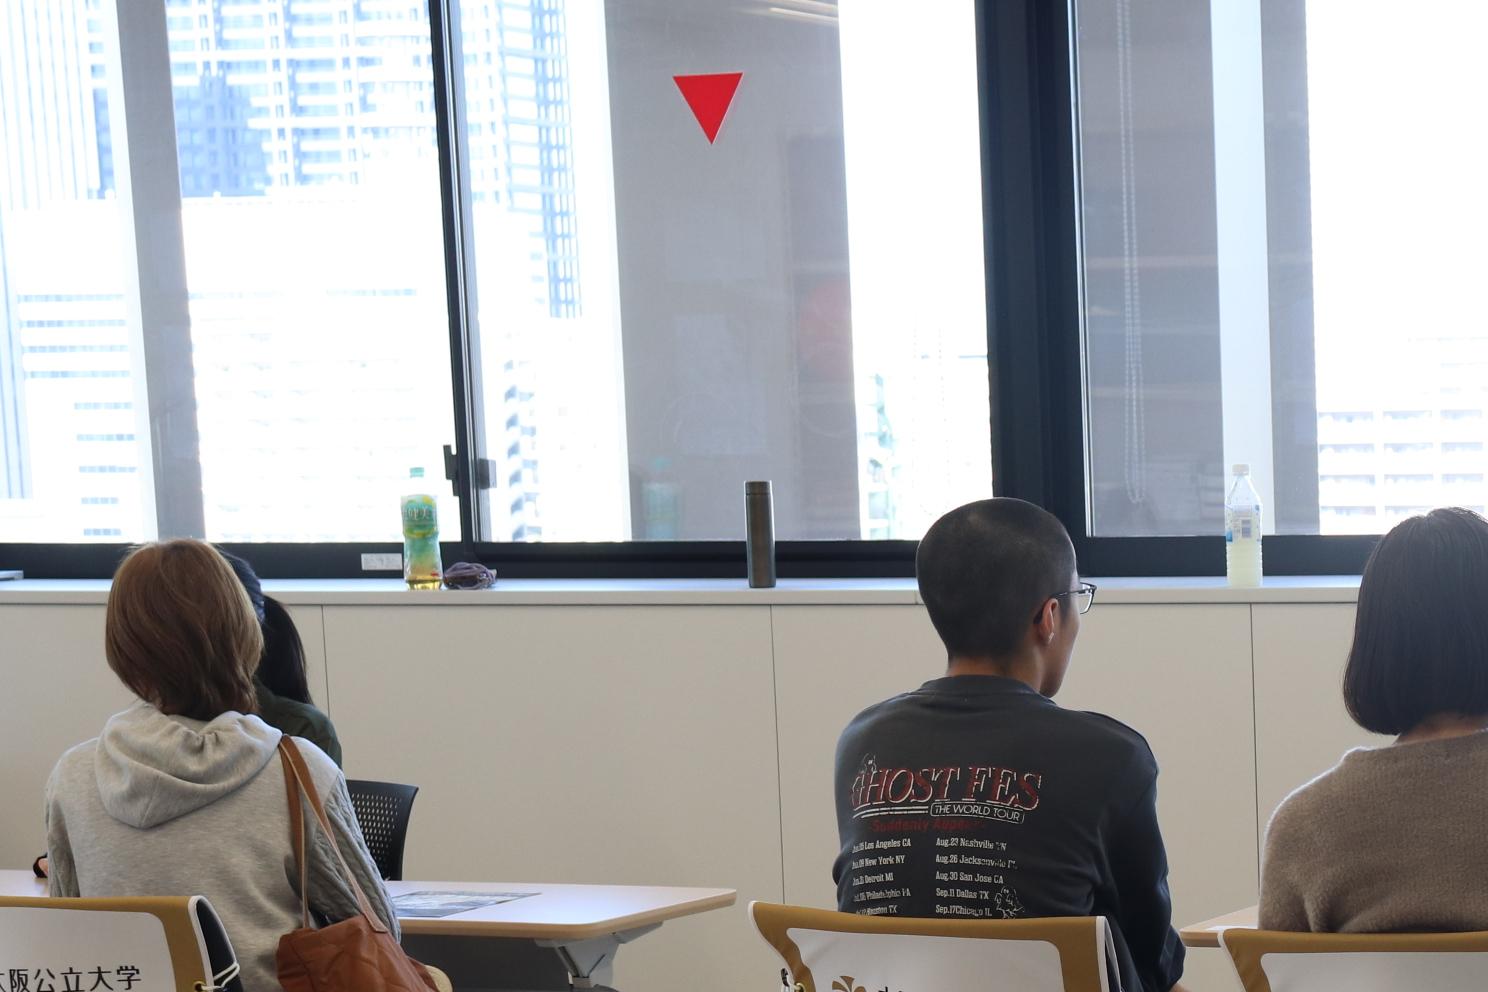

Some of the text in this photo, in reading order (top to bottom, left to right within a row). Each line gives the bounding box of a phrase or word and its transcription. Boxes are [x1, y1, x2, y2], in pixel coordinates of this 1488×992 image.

[962, 766, 1042, 811] FES
[935, 804, 1021, 821] THE WORLD TOUR
[864, 841, 875, 850] Los
[875, 839, 901, 850] Angeles
[902, 838, 912, 847] CA
[935, 837, 959, 847] Aug.23
[864, 858, 878, 867] New
[878, 855, 895, 865] York
[895, 854, 906, 864] NY
[935, 854, 959, 865] Aug.26
[885, 872, 894, 881] MI
[935, 871, 1004, 885] Aug.30 San Jose CA
[956, 888, 978, 899] Dallas
[979, 890, 990, 900] TX
